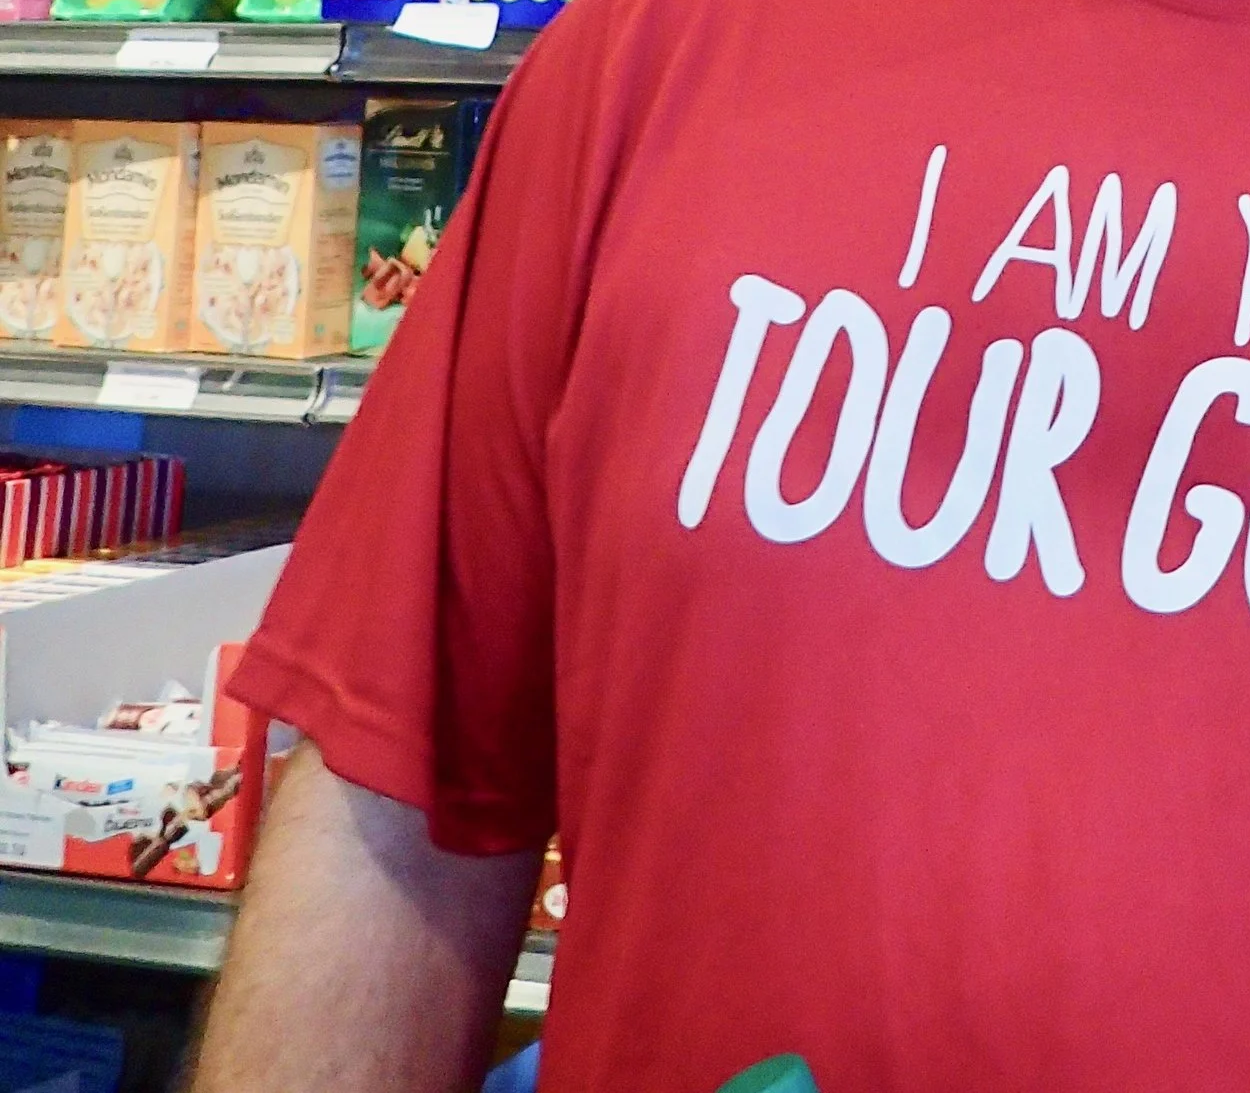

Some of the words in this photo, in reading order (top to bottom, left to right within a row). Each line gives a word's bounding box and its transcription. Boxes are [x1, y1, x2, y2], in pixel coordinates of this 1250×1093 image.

[898, 144, 947, 289] I
[972, 164, 1178, 331] AM
[677, 273, 1102, 598] TOUR
